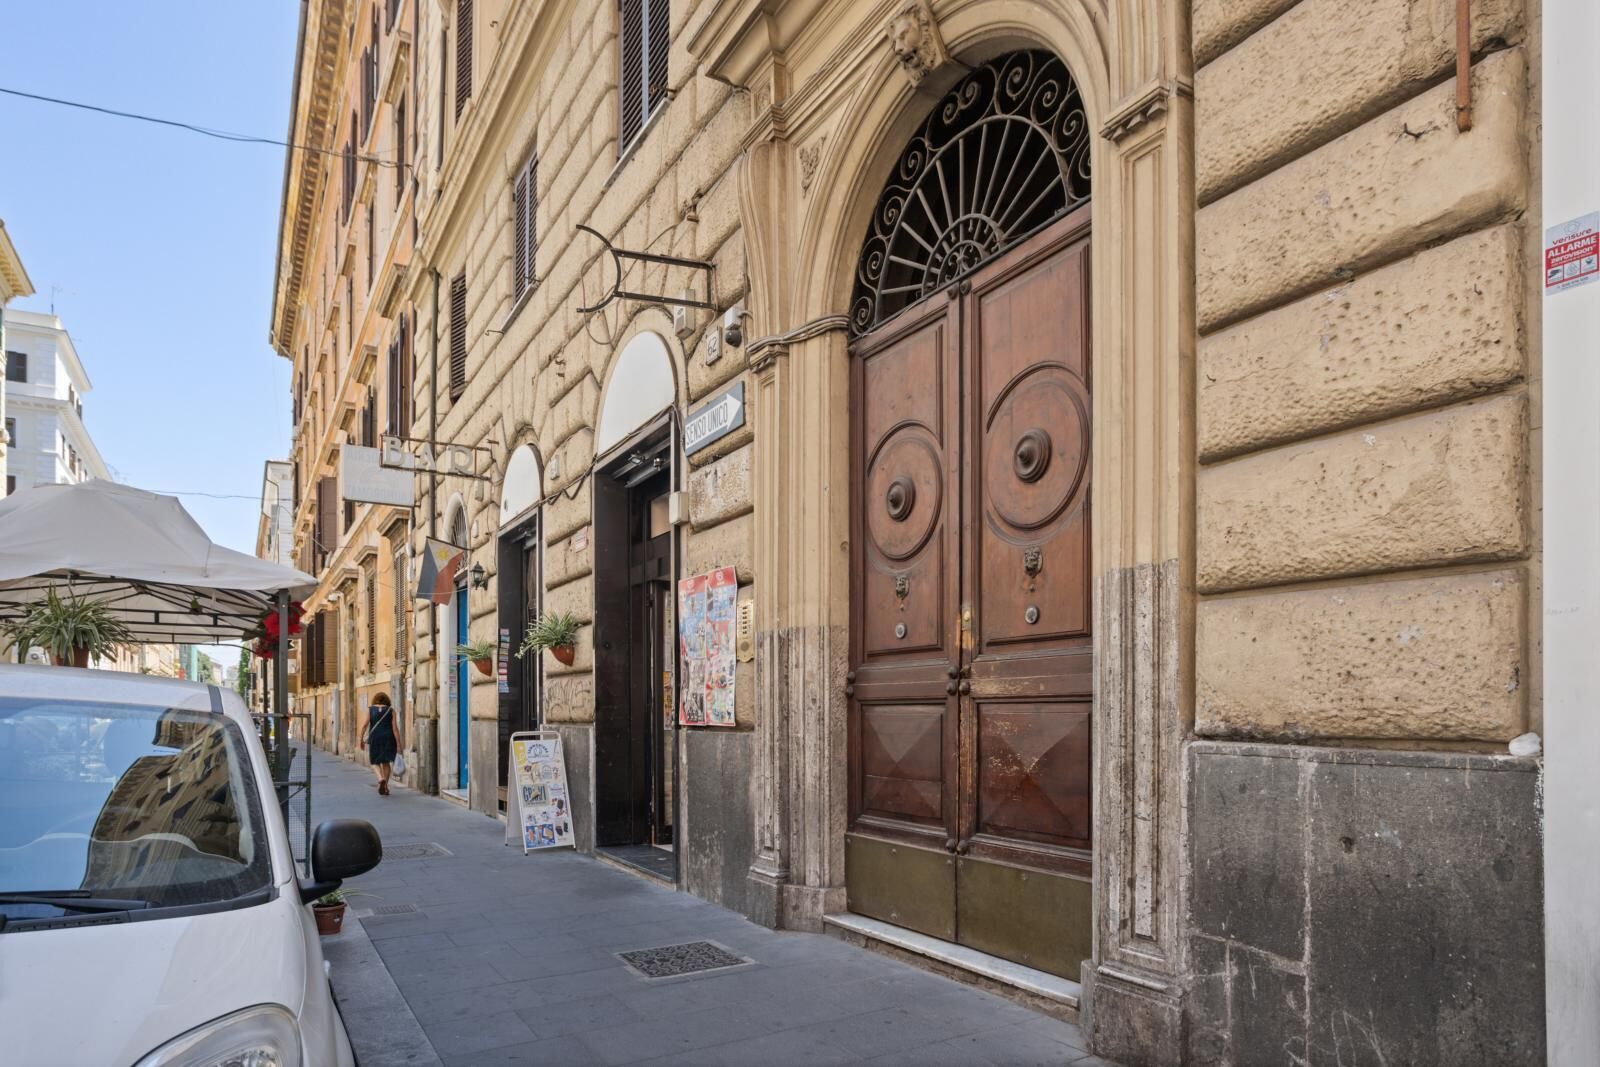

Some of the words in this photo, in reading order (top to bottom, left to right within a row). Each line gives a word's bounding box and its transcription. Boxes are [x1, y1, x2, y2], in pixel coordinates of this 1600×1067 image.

[1548, 235, 1598, 259] ALLARME
[1552, 228, 1592, 245] verisure
[686, 415, 707, 446] SENSO
[707, 402, 728, 433] UNICO
[383, 436, 476, 475] BAR
